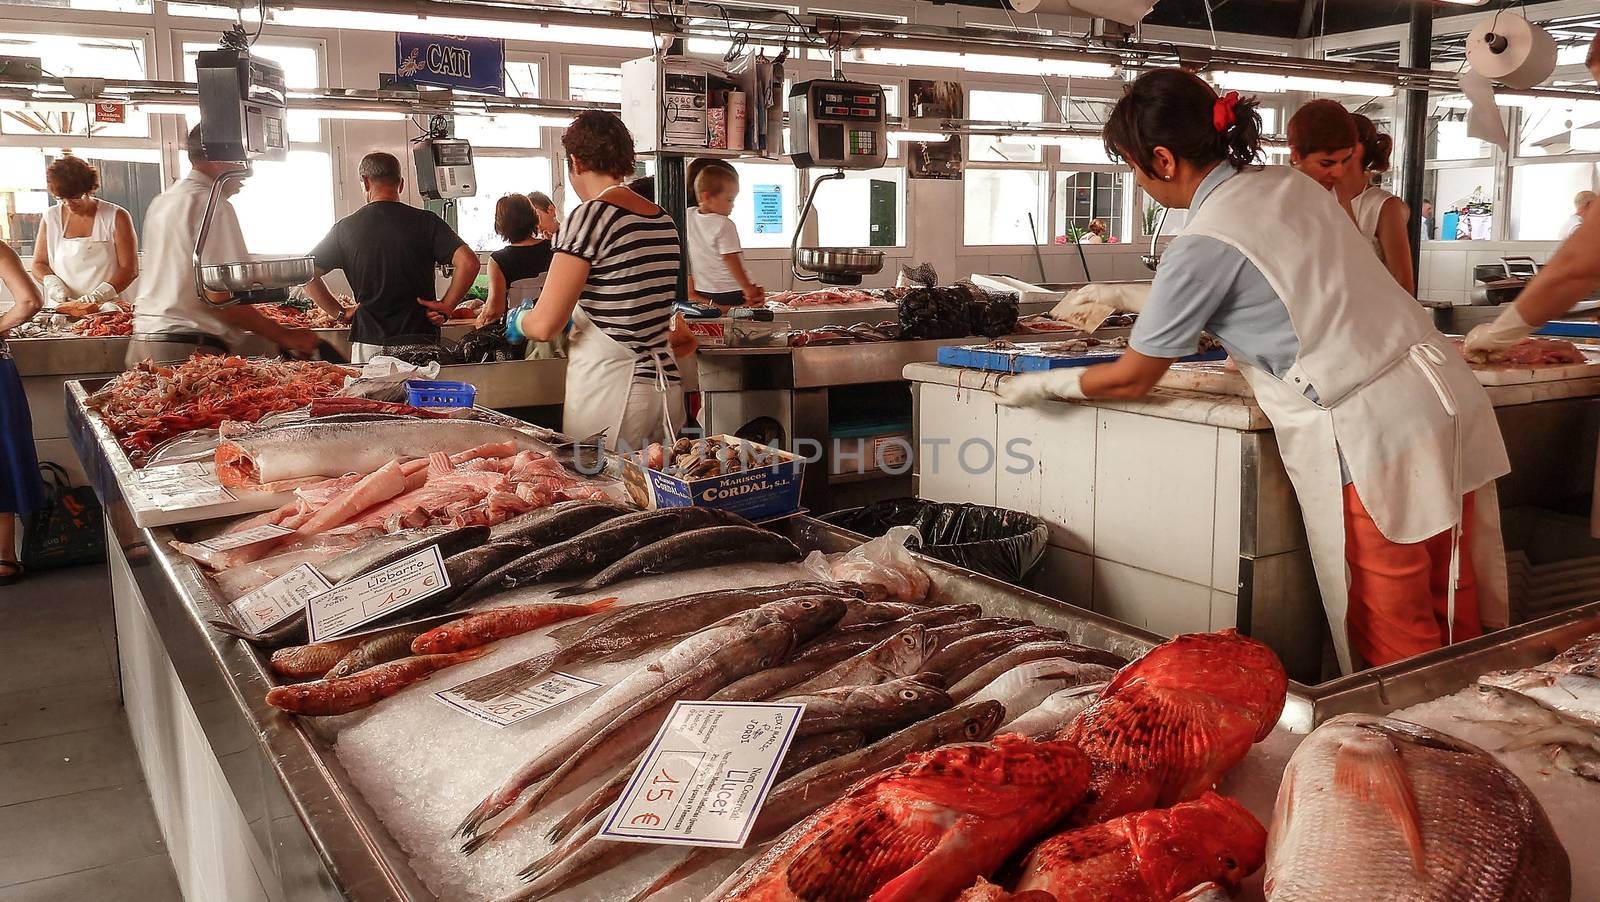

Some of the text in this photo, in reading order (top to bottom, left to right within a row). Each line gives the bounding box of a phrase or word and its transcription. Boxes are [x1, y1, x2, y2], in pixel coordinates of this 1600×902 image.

[426, 43, 471, 78] CATI
[367, 560, 424, 589] Llobarro
[423, 575, 435, 587] €
[739, 718, 759, 744] JORDI
[745, 766, 762, 783] Nom
[630, 768, 680, 826] 15 €
[708, 769, 750, 816] Llucet
